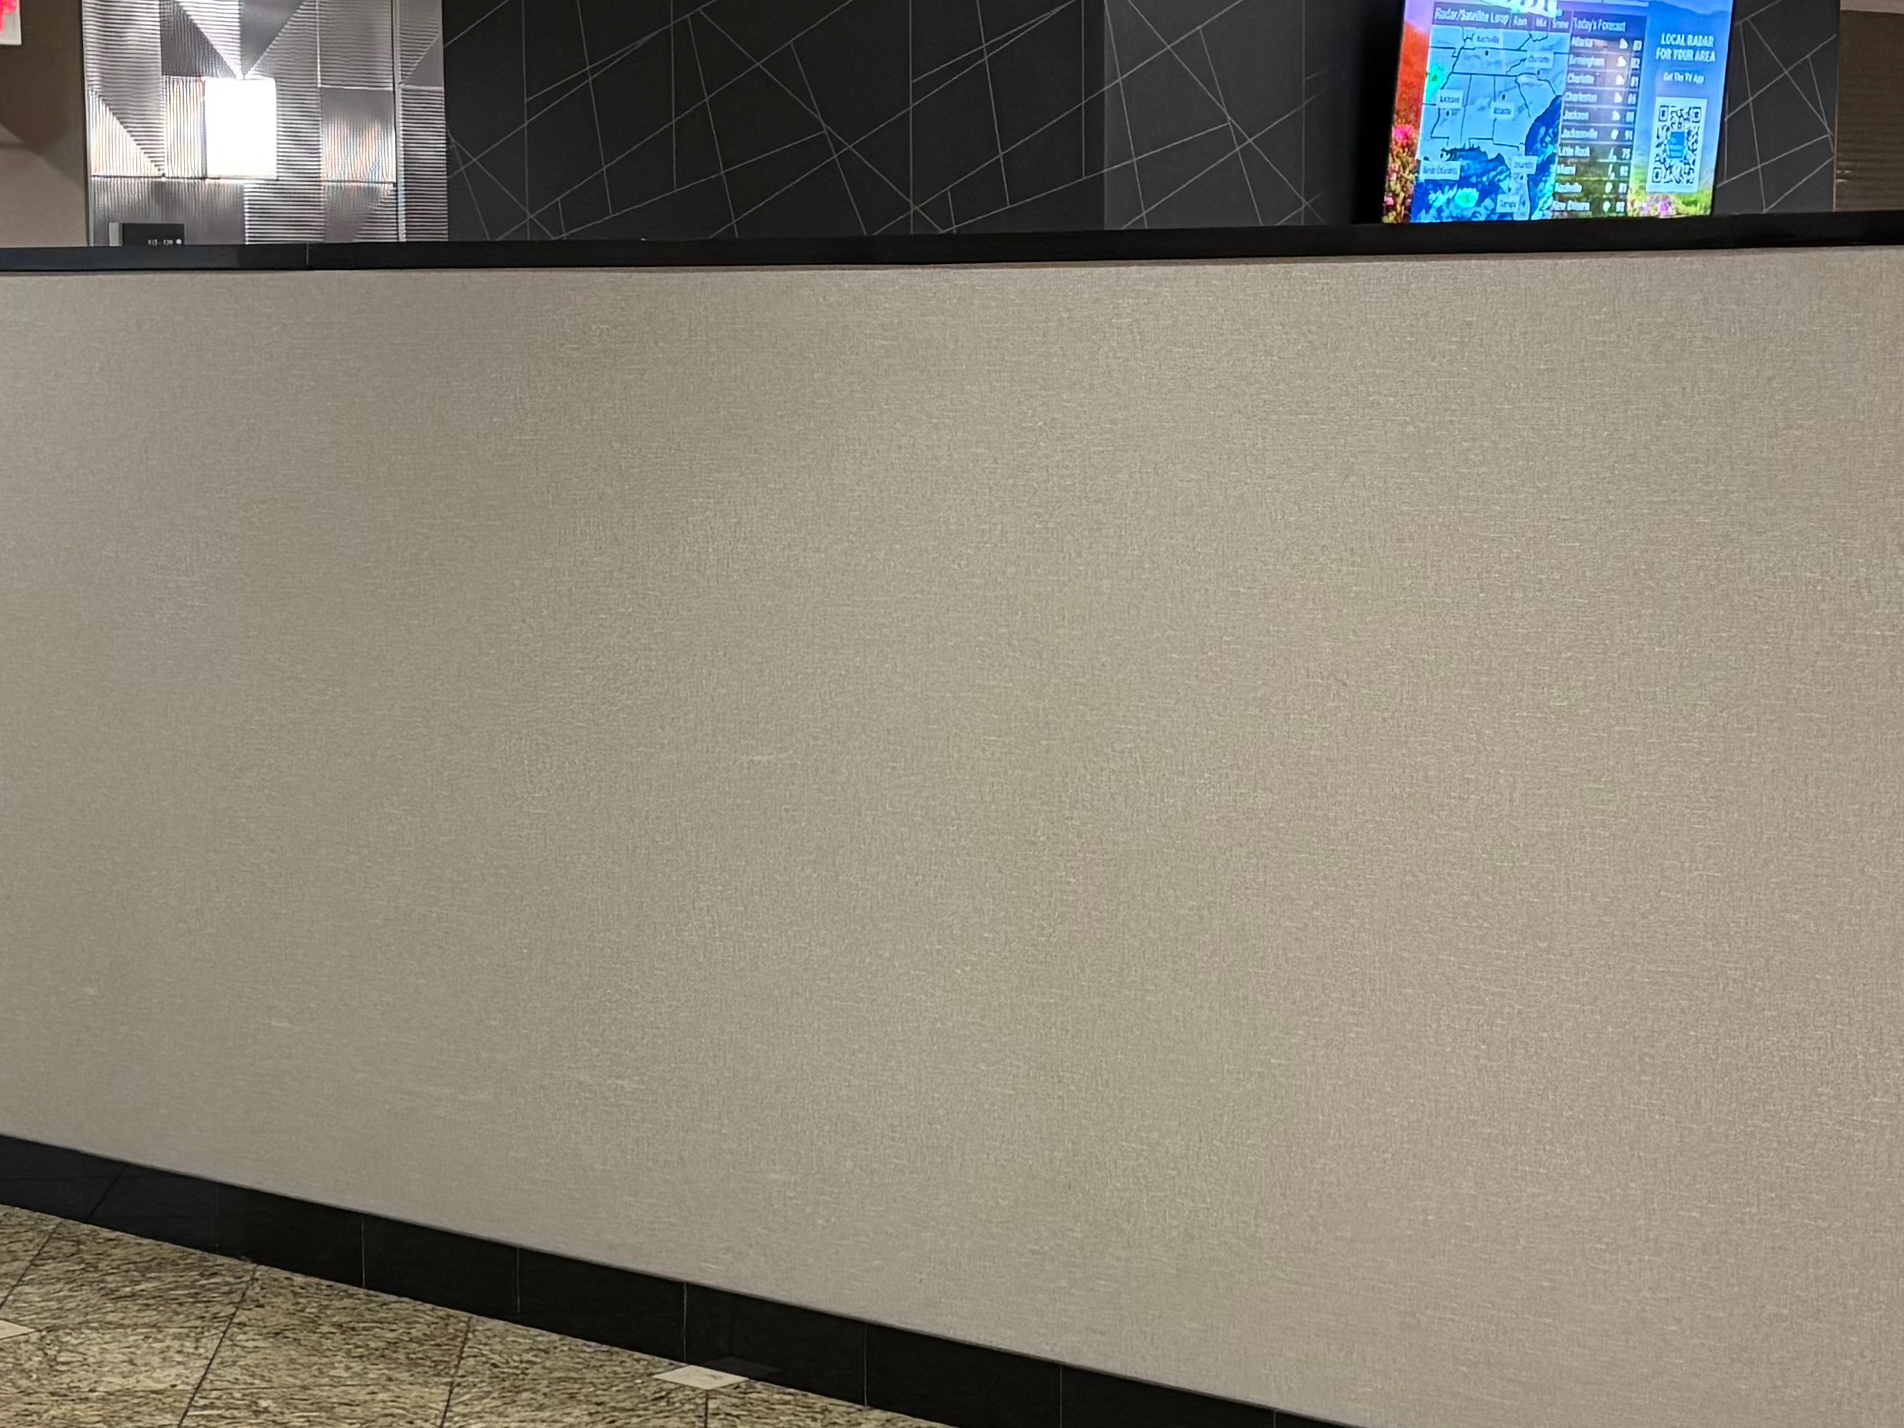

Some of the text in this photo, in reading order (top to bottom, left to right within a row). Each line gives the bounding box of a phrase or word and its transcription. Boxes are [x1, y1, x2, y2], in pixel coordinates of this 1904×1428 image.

[1573, 17, 1627, 32] Today's Forecast
[1660, 32, 1715, 47] LOCAL RADAR
[1655, 47, 1716, 62] FOR YOUR AREA
